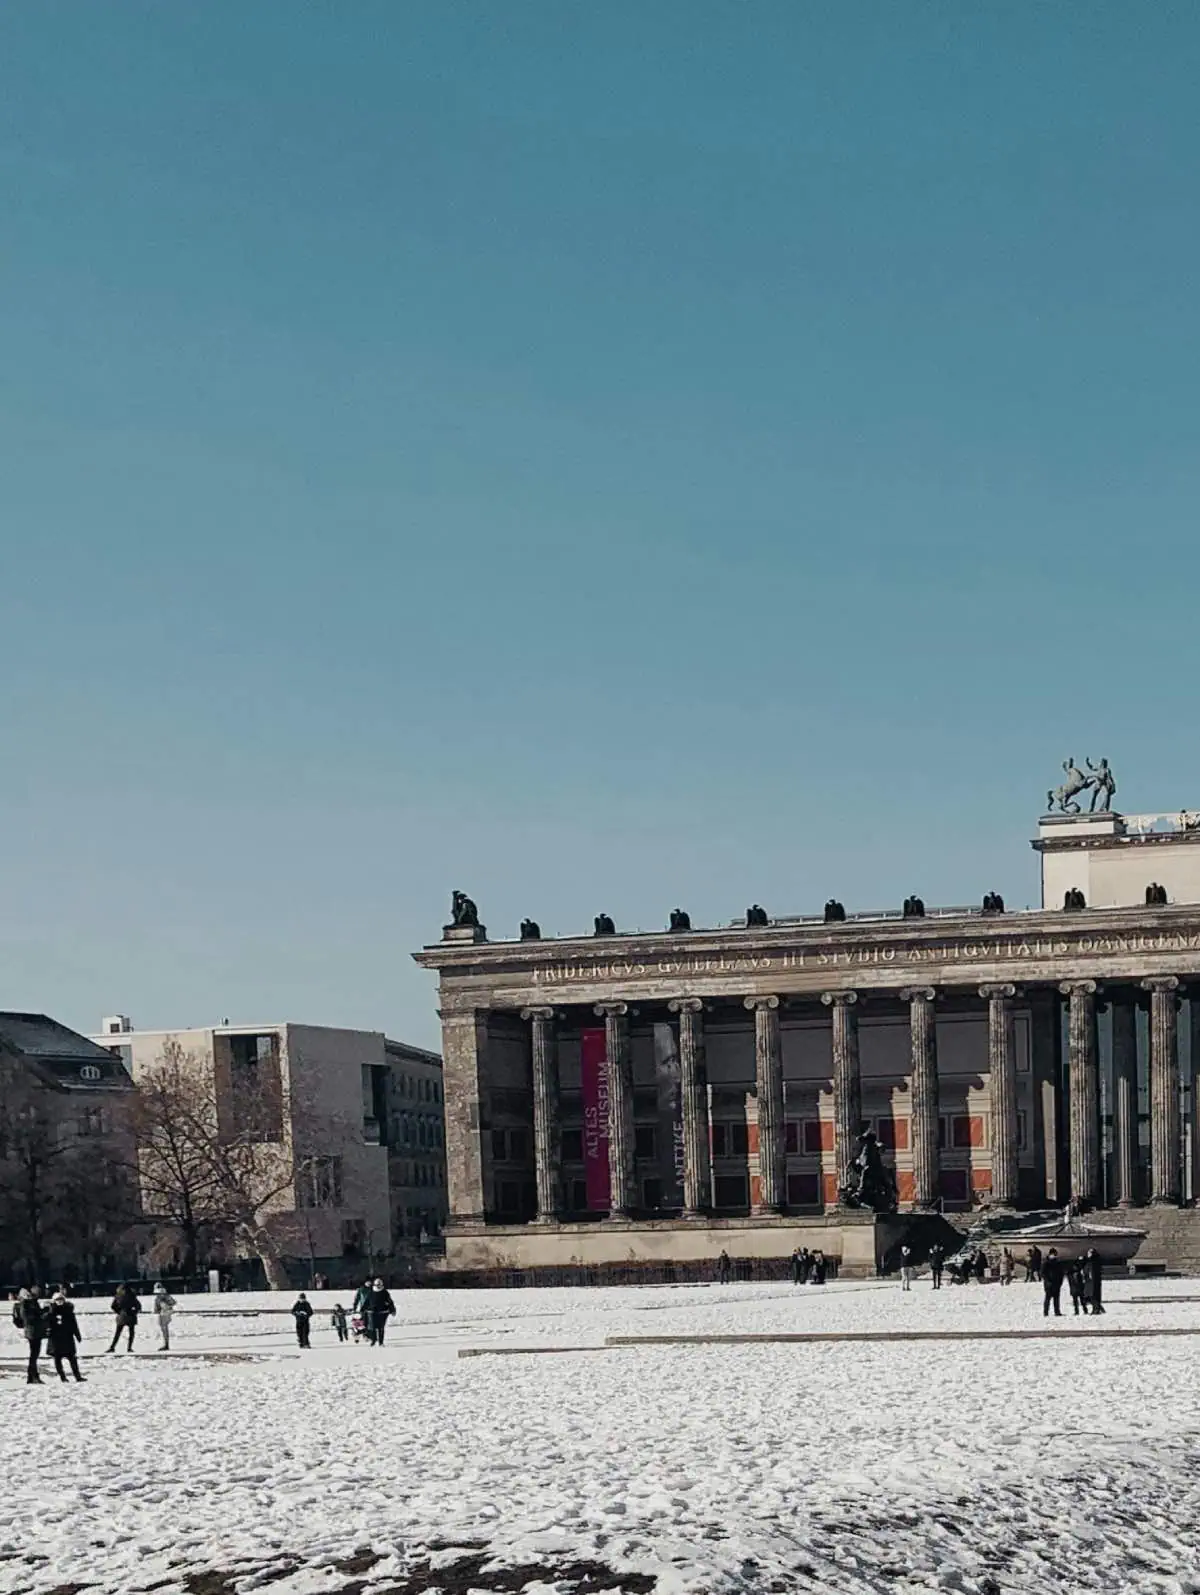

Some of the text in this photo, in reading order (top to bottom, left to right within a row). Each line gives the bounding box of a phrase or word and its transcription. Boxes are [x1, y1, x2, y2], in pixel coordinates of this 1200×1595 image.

[783, 951, 805, 966] III
[817, 947, 895, 965] STVDIO
[908, 939, 1069, 961] ANTIQVITATIS
[586, 1106, 599, 1158] ALTES
